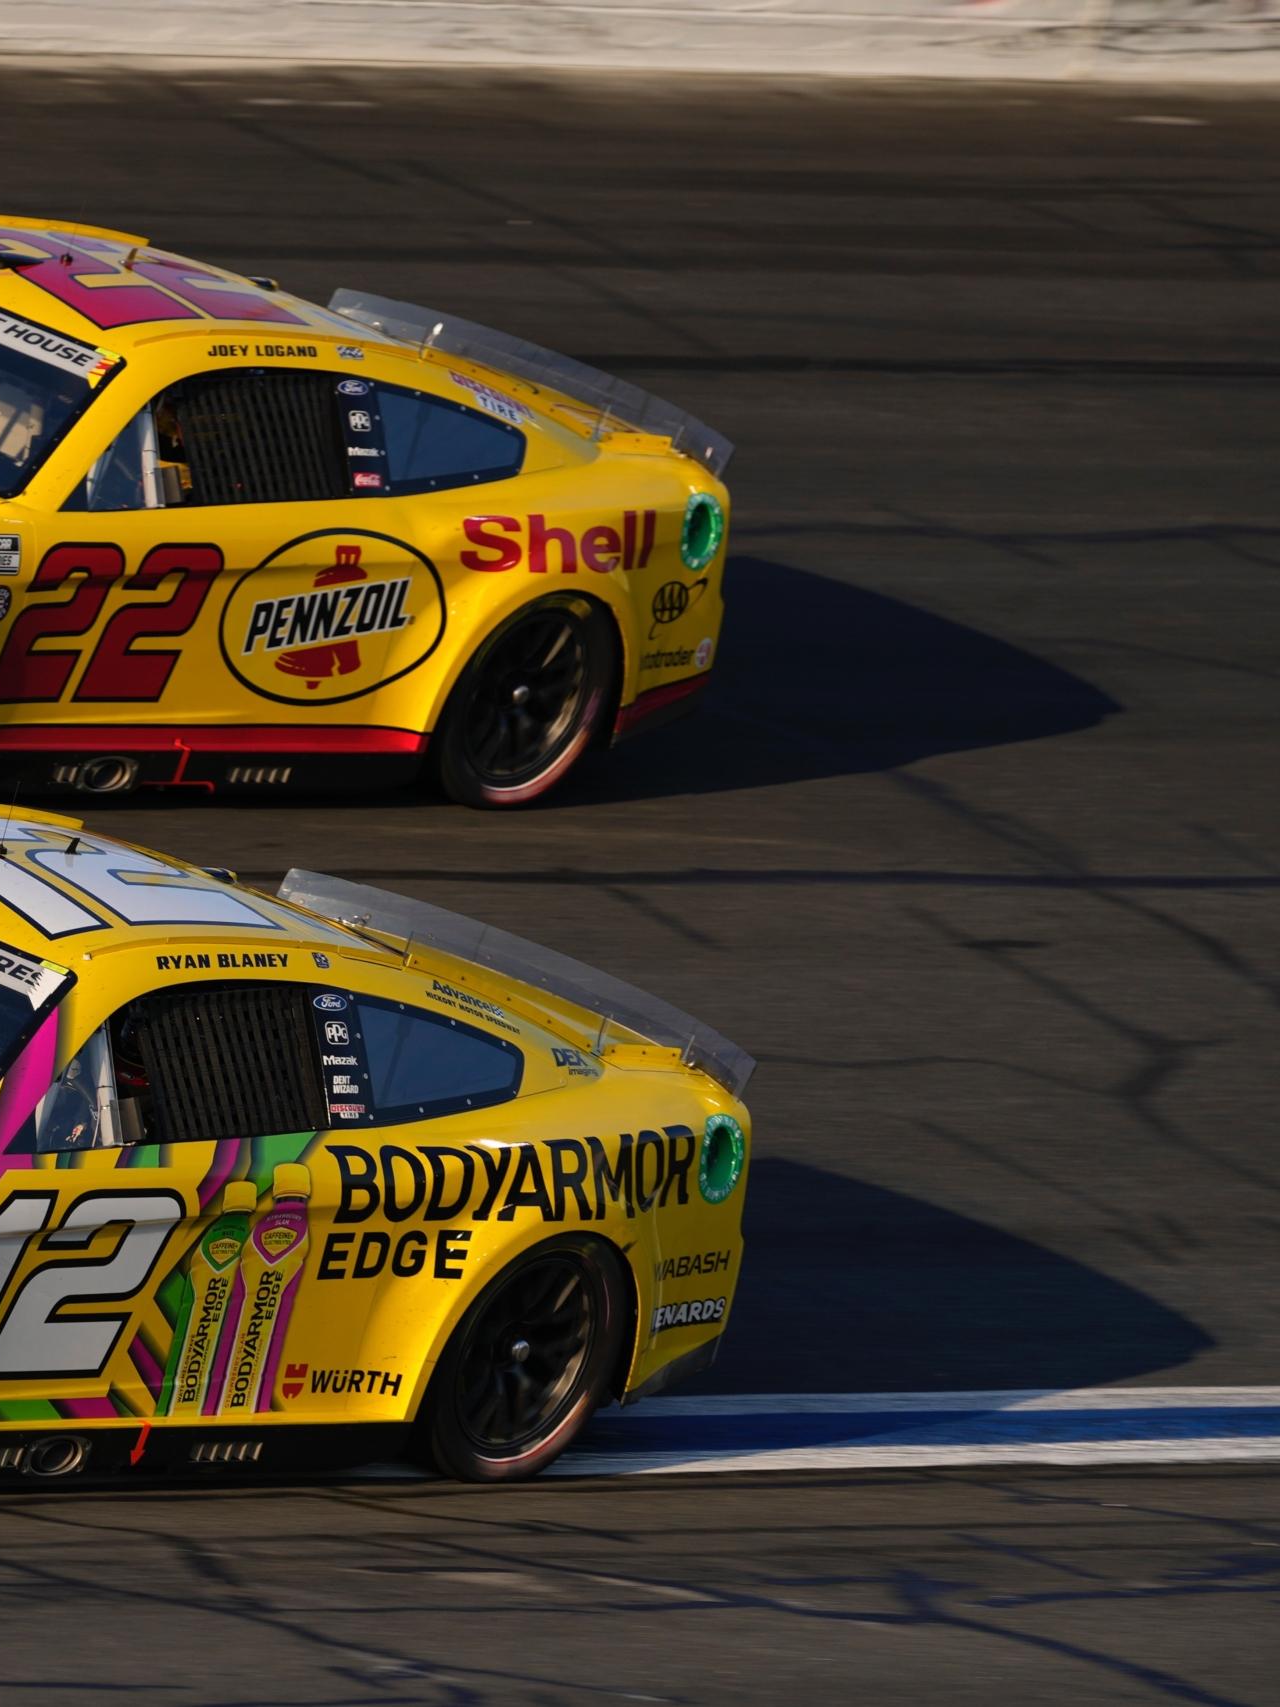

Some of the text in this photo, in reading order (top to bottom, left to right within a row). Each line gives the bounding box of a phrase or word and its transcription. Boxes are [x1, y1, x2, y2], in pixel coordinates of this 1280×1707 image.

[3, 323, 94, 367] HOUSE
[207, 344, 318, 359] JOEY LOGANO
[460, 510, 657, 574] Shell
[242, 577, 413, 656] PENNZOIL
[156, 953, 289, 970] RYAN BLANEY
[320, 994, 342, 1008] Ford
[327, 1023, 348, 1042] PPG
[322, 1054, 359, 1066] Mazak
[551, 1047, 589, 1067] DEX
[332, 1075, 351, 1084] DENT
[332, 1084, 359, 1094] WIZARD
[325, 1124, 696, 1224] BODYARMOR
[317, 1229, 473, 1281] EDGE
[211, 1276, 229, 1323] EDGE
[264, 1270, 284, 1321] EDGE
[181, 1277, 222, 1404] BODYARMOR
[230, 1270, 276, 1409] BODYARMOR
